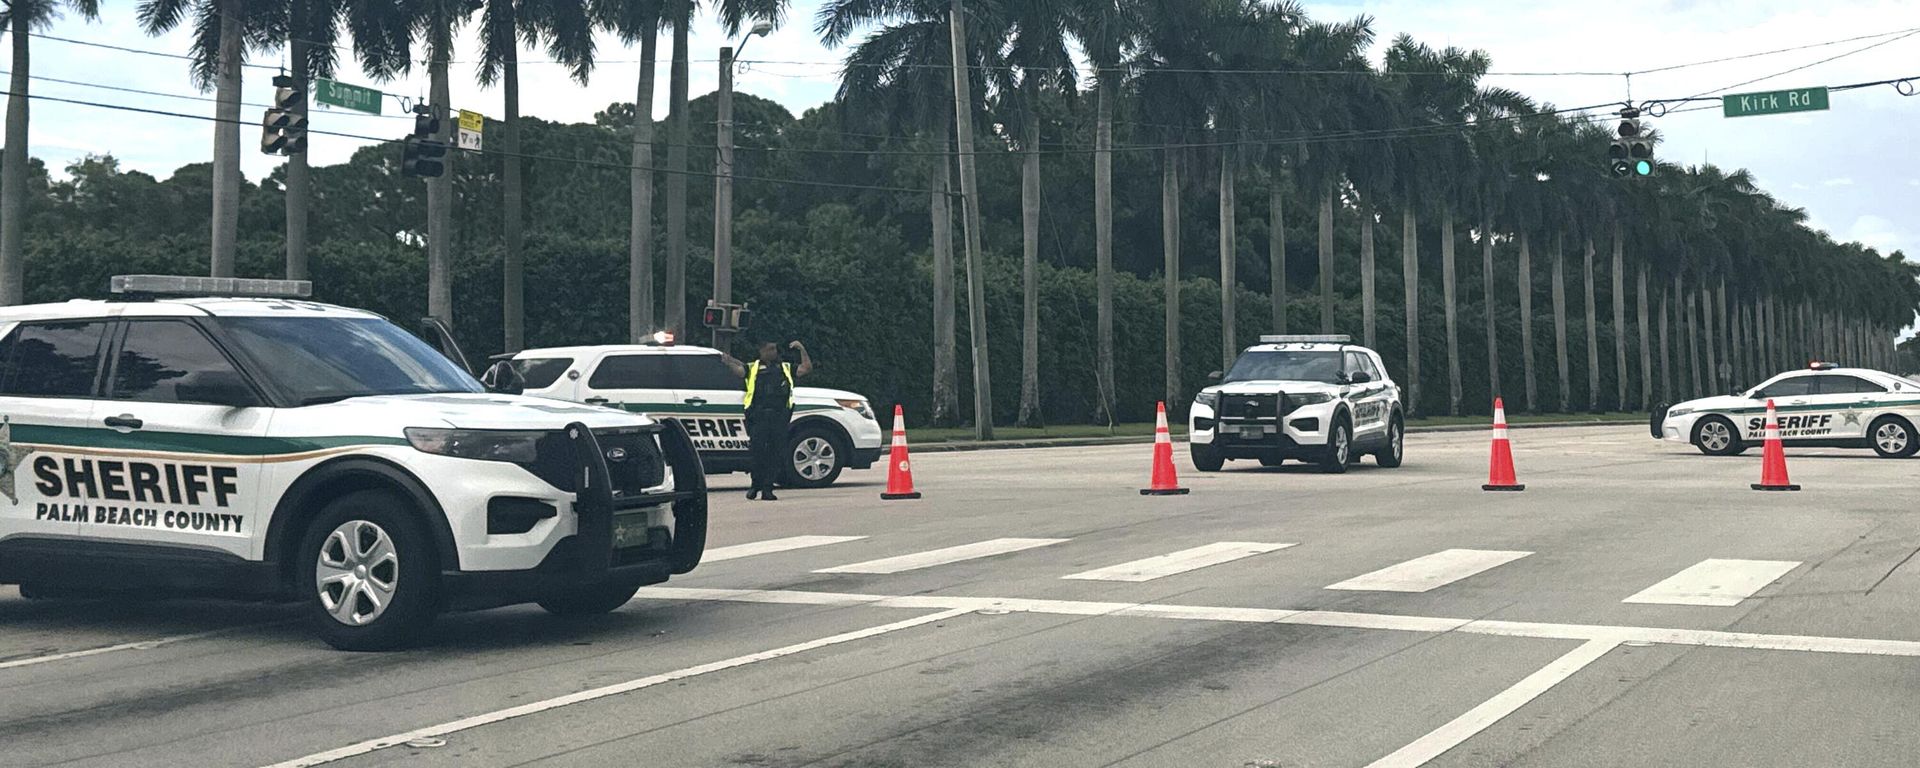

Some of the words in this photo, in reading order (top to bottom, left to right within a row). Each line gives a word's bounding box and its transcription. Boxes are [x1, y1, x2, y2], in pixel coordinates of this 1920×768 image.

[329, 81, 371, 105] Summit
[1741, 95, 1779, 112] Kirk
[1789, 91, 1810, 107] Rd
[680, 418, 750, 437] ERIF
[1800, 428, 1832, 436] COUNTY
[694, 440, 715, 448] ACH
[720, 440, 751, 448] COUN
[33, 456, 238, 507] SHERIFF
[36, 502, 89, 523] PALM
[94, 507, 157, 527] BEACH
[164, 510, 243, 533] COUNTY
